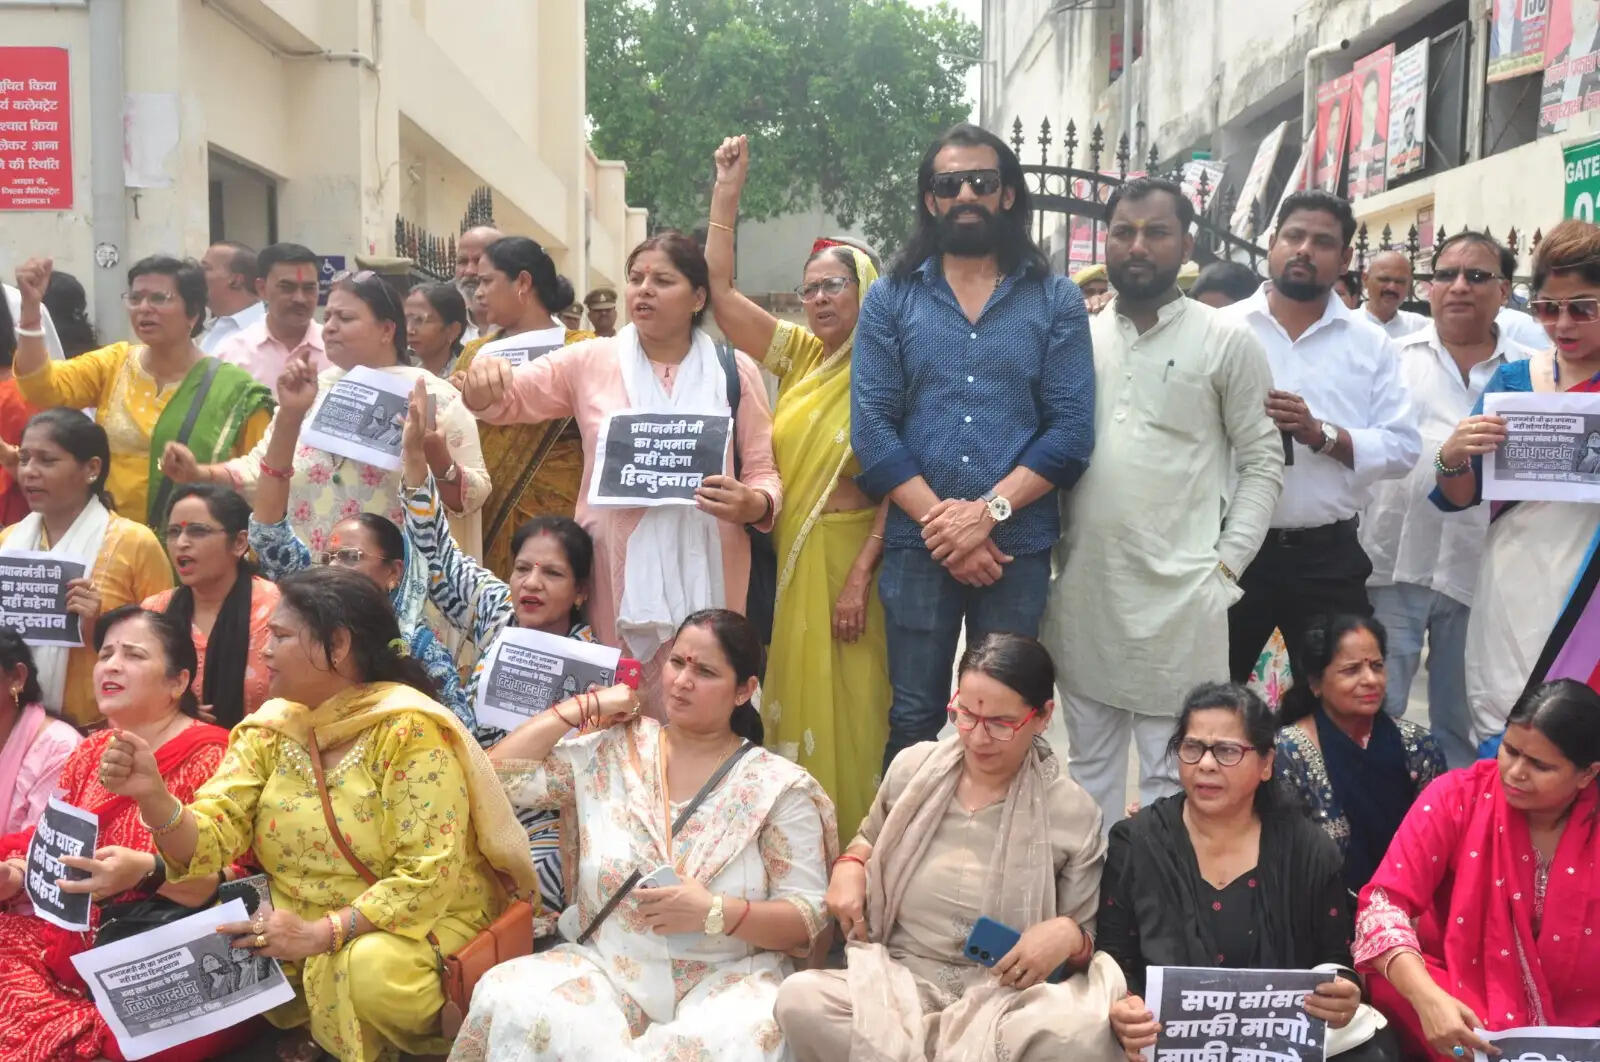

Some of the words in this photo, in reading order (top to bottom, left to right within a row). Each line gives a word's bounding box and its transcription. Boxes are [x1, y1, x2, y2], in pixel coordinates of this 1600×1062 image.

[29, 78, 57, 91] किया
[30, 119, 58, 131] किया
[8, 158, 25, 170] की
[28, 157, 60, 170] स्थिति
[1566, 154, 1600, 184] GATE
[1573, 190, 1600, 224] 0
[631, 421, 686, 434] प्रधानमंत्री
[687, 421, 704, 434] जी
[634, 438, 651, 449] का
[653, 439, 697, 450] अपमान
[1505, 443, 1537, 459] विरोध
[1537, 443, 1574, 460] प्रदर्शन
[634, 451, 659, 465] नहीं
[659, 452, 692, 467] सहेगा
[620, 464, 703, 494] हिन्दुस्तान
[46, 566, 62, 580] जी
[1, 581, 15, 592] का
[15, 582, 59, 595] अपमान
[2, 593, 24, 608] नहीं
[23, 595, 56, 609] सहेगा
[56, 831, 85, 857] यादव
[122, 993, 160, 1016] विरोध
[159, 980, 200, 1008] प्रदर्शन
[1181, 990, 1236, 1011] सपा
[1165, 1013, 1238, 1038] माफी
[1240, 1011, 1316, 1046] मांगो.
[1157, 1040, 1229, 1062] माफी
[1232, 1042, 1303, 1062] मांगो
